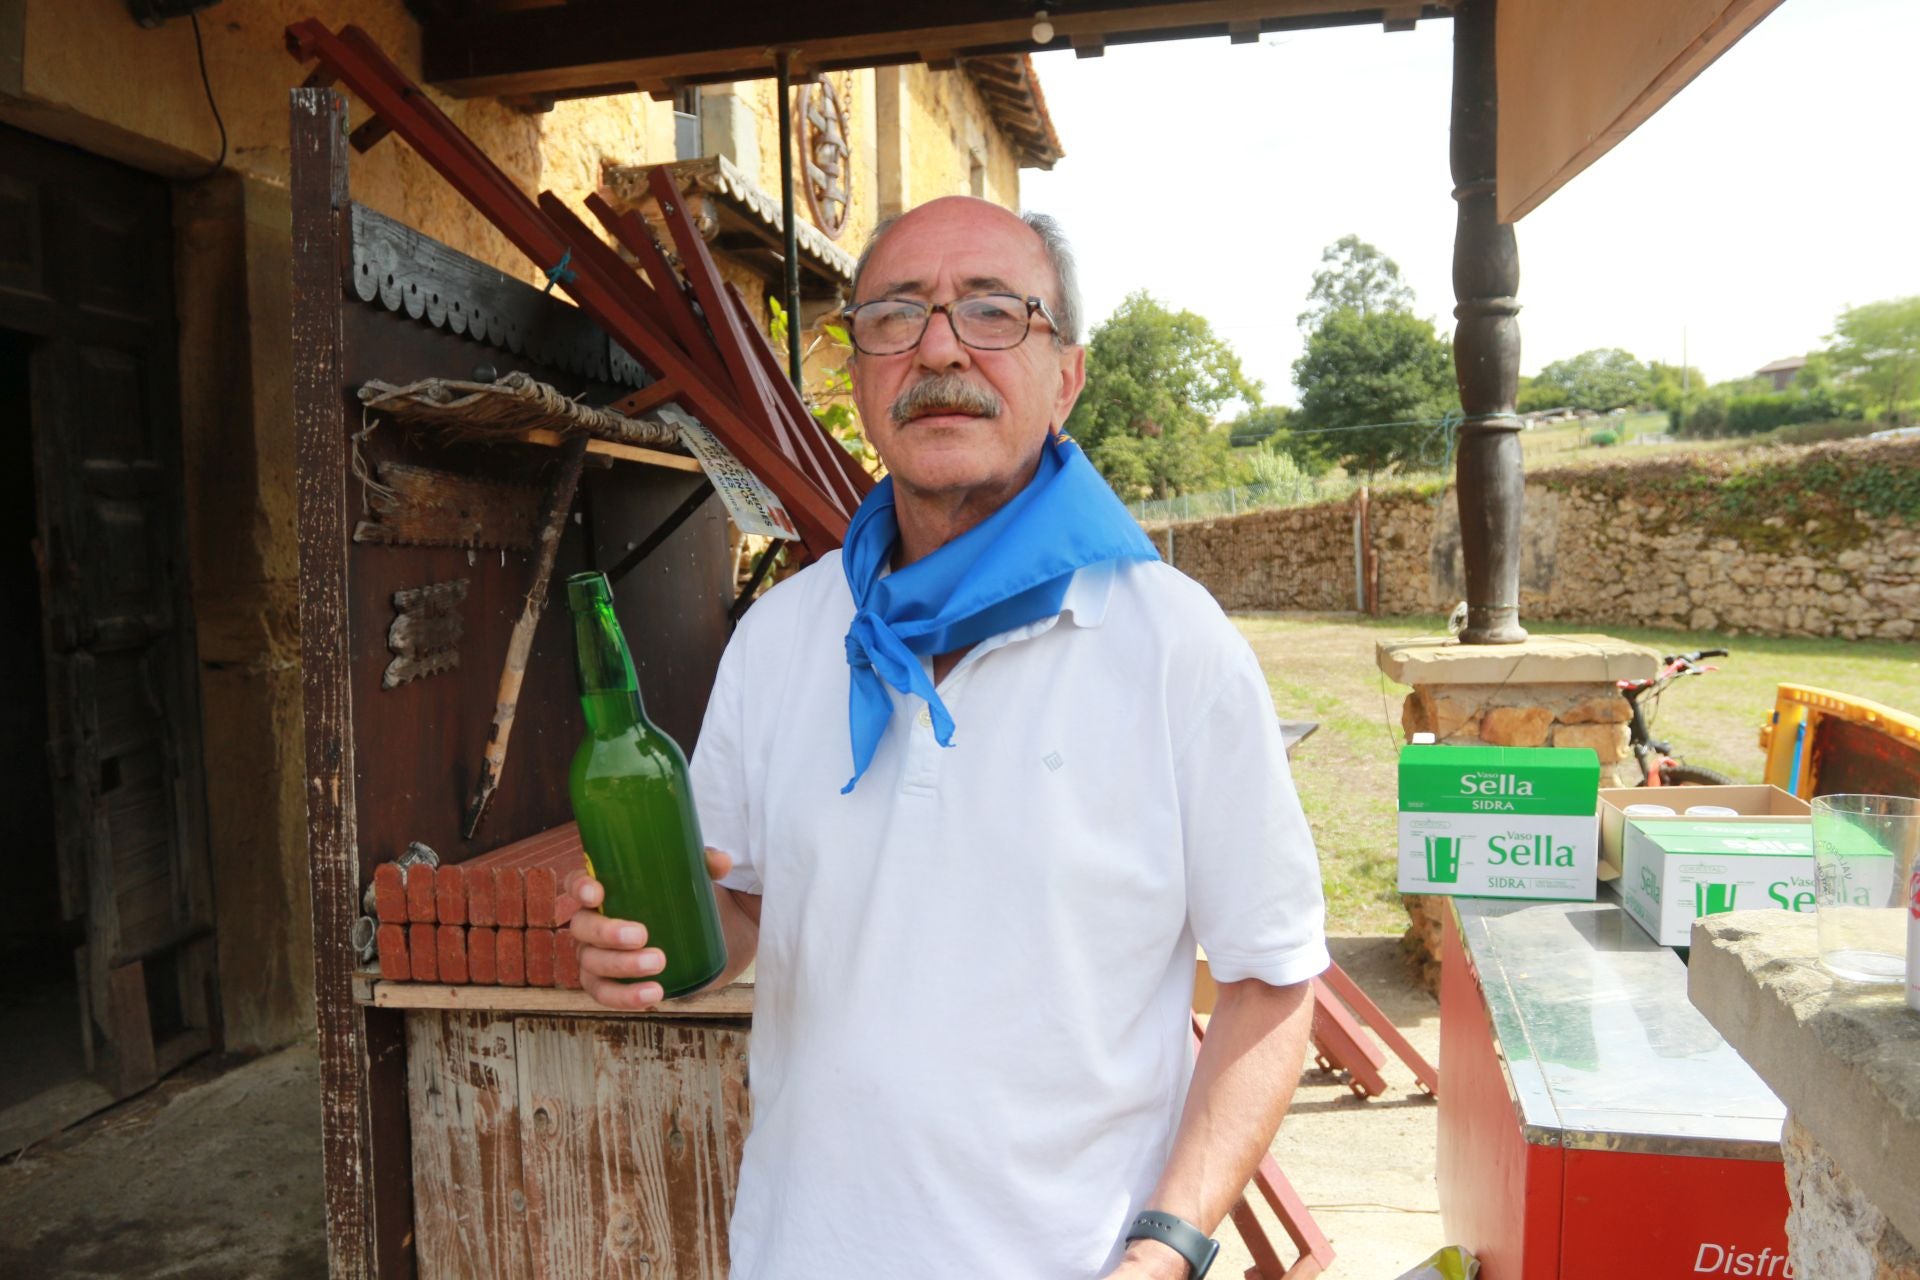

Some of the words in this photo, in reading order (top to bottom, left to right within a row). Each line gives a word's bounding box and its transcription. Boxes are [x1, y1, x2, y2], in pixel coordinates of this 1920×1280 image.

[716, 462, 736, 489] FAES
[735, 468, 773, 527] COMEDIES
[1477, 771, 1499, 779] Vaso
[1460, 773, 1534, 796] Sella
[1472, 800, 1515, 811] SIDRA
[1506, 830, 1533, 841] Vaso
[1487, 834, 1576, 867] Sella
[1488, 878, 1526, 889] SIDRA
